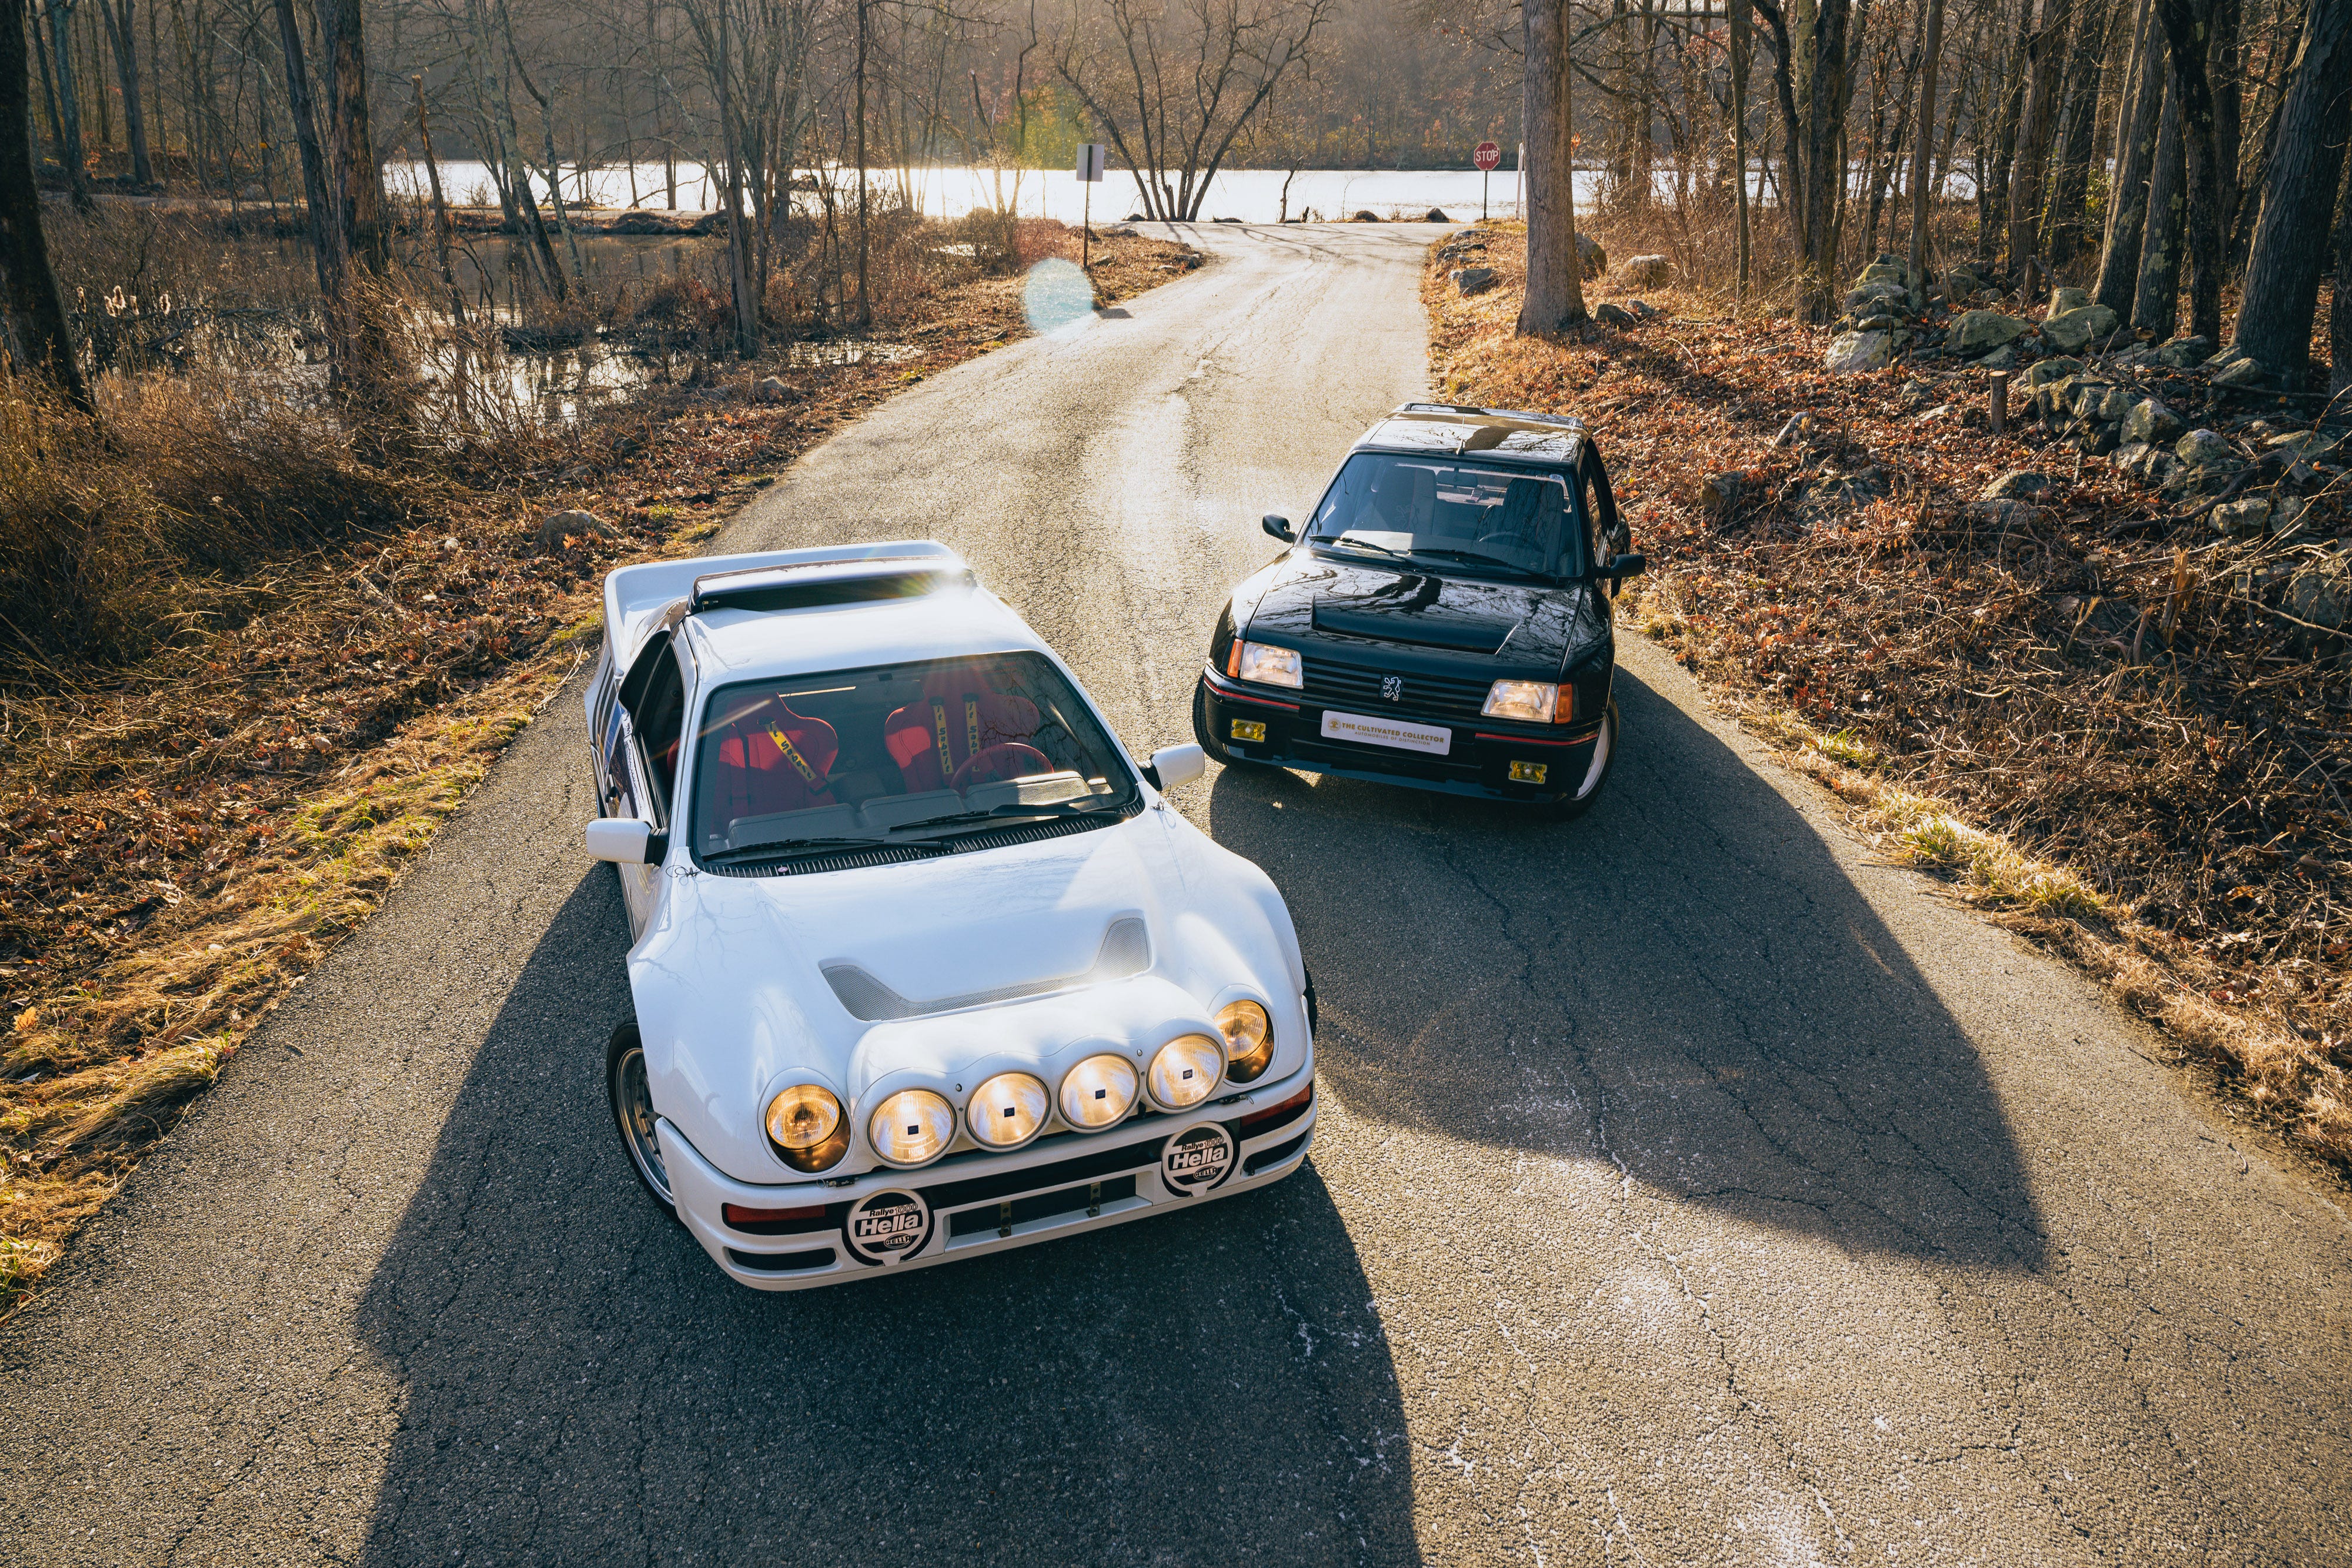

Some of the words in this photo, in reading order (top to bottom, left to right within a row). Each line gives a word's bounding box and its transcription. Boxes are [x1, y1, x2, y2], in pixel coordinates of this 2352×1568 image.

[1475, 150, 1498, 162] STOP
[1357, 725, 1400, 736] CULTIVATED
[1402, 731, 1444, 743] COLLECTOR
[1399, 737, 1431, 746] DISTINCTION
[939, 727, 950, 772] Sabelt
[781, 740, 811, 778] Sabelt
[1181, 1142, 1203, 1151] Rallye
[1204, 1136, 1224, 1148] 1000
[1172, 1147, 1225, 1169] Hella
[1195, 1168, 1217, 1176] HELLA
[869, 1208, 894, 1217] Rallye
[894, 1203, 918, 1214] 1000
[860, 1214, 918, 1236] Hella
[886, 1235, 911, 1244] HELLA
